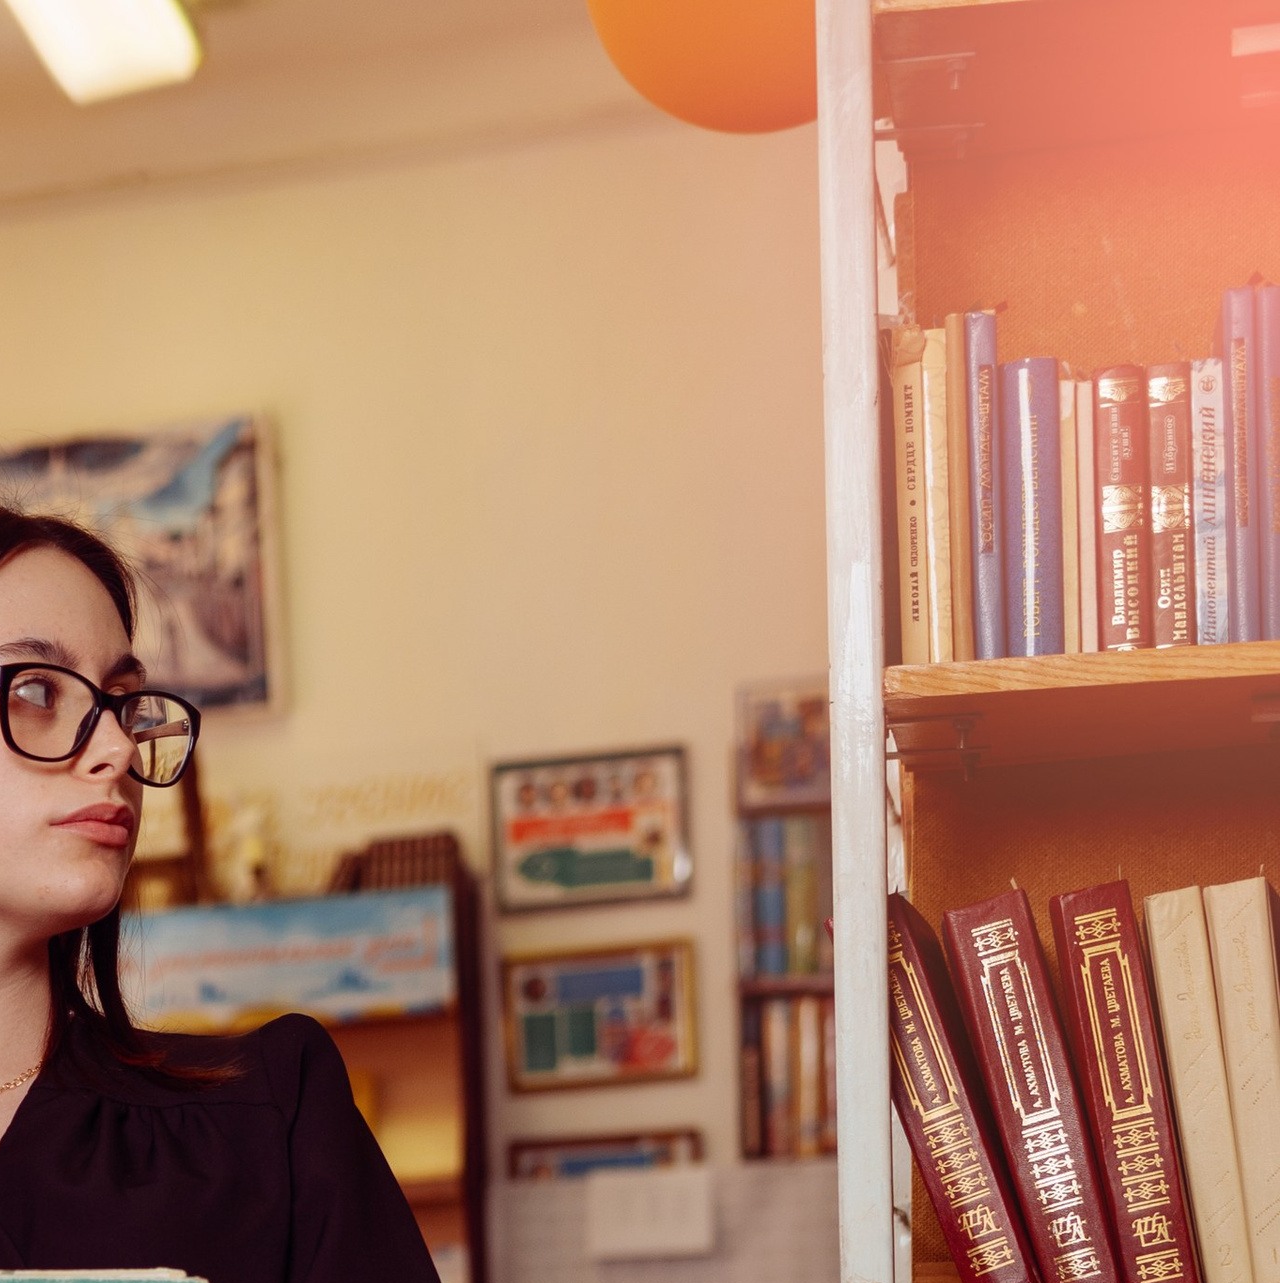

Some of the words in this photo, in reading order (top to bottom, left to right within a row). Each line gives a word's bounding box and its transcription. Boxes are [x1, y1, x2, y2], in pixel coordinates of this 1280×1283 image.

[903, 383, 914, 434] ПОМНИТ
[977, 367, 994, 489] МАНДЕЛЬШТАМ
[905, 440, 916, 492] СЕРДЦЕ
[980, 497, 994, 543] ОСИП
[999, 965, 1024, 1021] ЦВЕТАЕВА
[1100, 956, 1121, 1013] ЦВЕТАЕВА
[903, 1020, 916, 1033] М.
[909, 1036, 937, 1092] АХМАТОВА
[1016, 1038, 1041, 1097] АХМАТОВА
[1112, 1032, 1132, 1089] АХМАТОВА
[929, 1093, 941, 1105] А.
